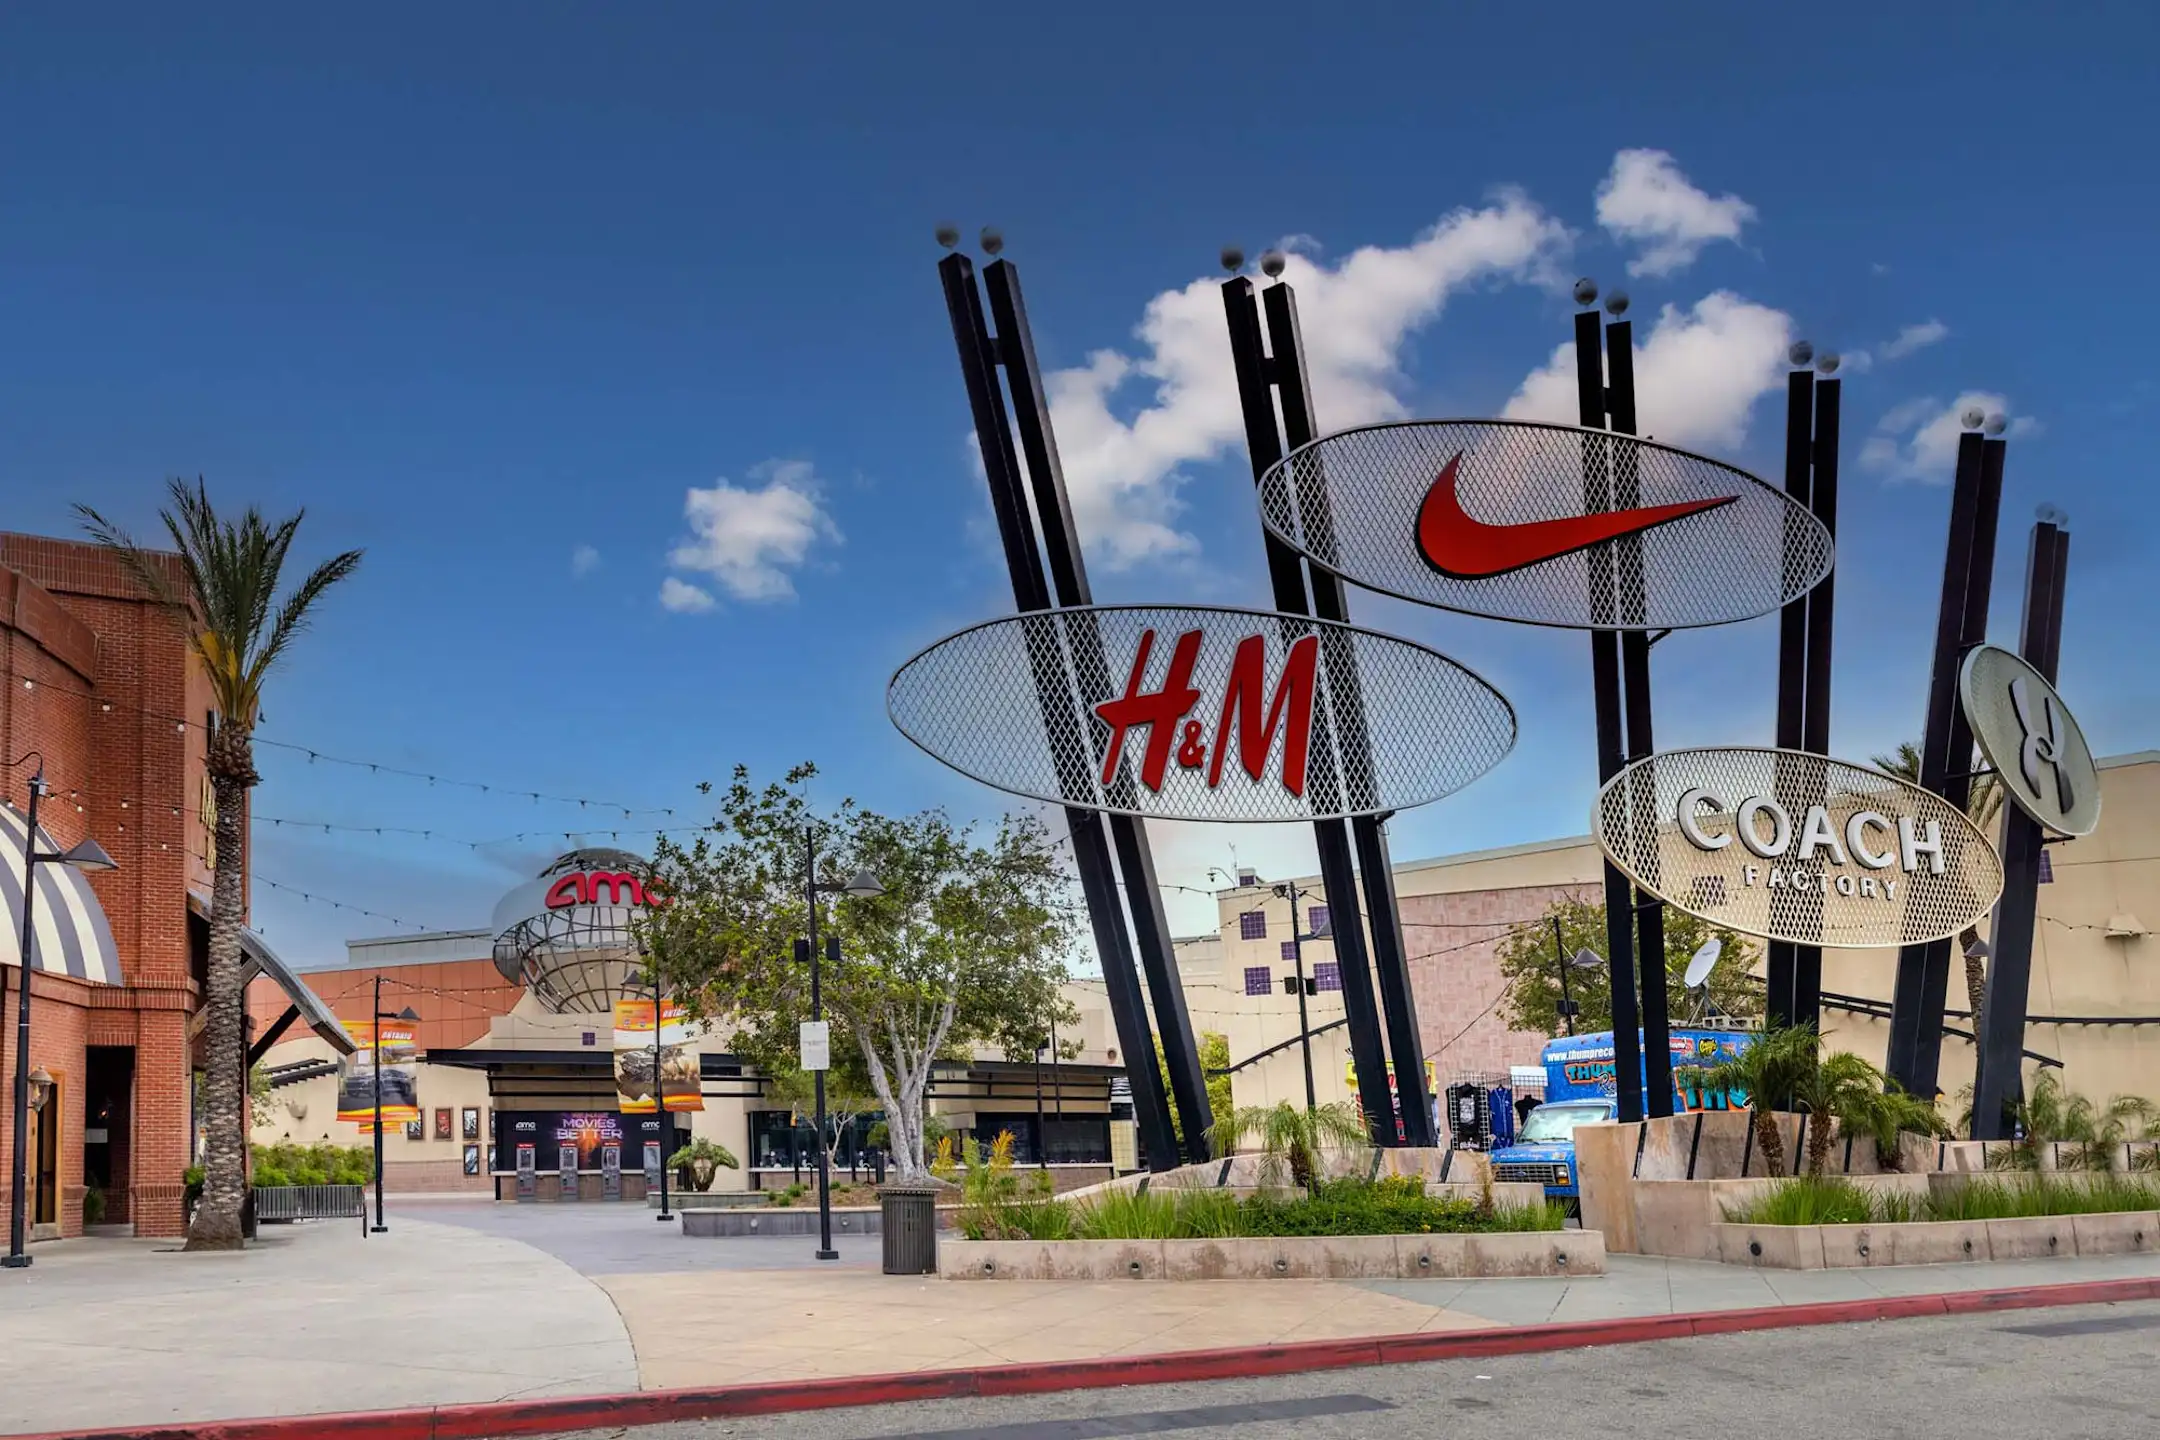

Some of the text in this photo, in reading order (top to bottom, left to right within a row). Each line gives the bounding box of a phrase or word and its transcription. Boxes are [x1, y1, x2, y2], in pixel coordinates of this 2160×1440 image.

[1095, 629, 1318, 798] H&M
[1678, 787, 1945, 875] COACH
[1743, 864, 1897, 900] FACTORY
[557, 1129, 623, 1139] BETTER
[562, 1118, 616, 1128] MOVIES
